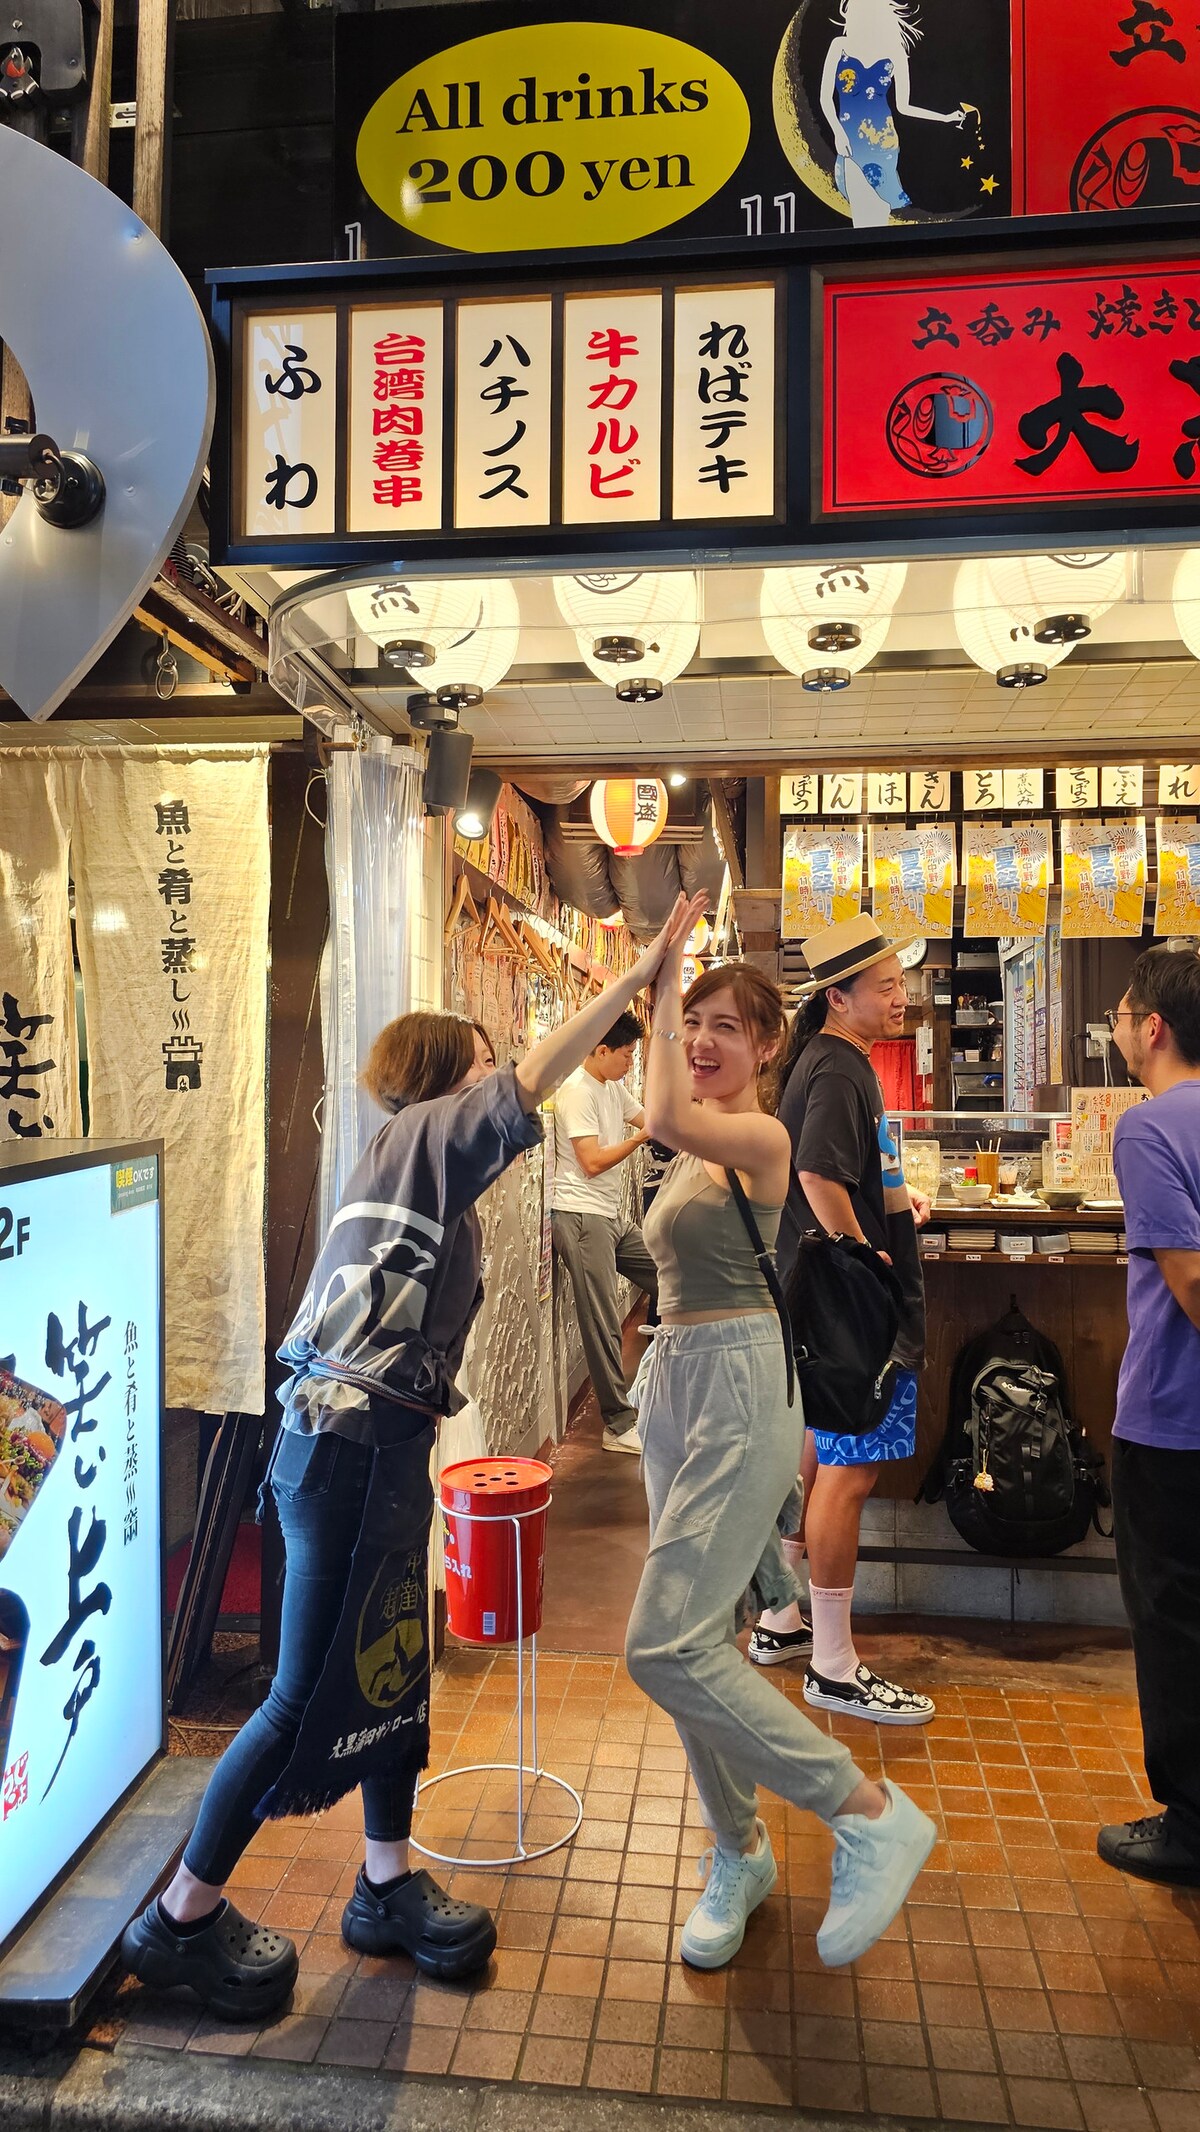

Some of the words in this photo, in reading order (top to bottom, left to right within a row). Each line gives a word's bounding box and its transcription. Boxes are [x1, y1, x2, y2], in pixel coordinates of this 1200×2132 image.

[1107, 0, 1200, 68] 立
[395, 81, 485, 134] All
[502, 67, 710, 126] drinks
[407, 150, 566, 204] 200
[581, 152, 696, 201] yen
[911, 302, 1061, 350] 立呑み
[264, 343, 322, 510] ふわ
[372, 332, 426, 508] 台湾肉巻串
[478, 333, 532, 501] ハチノス
[585, 327, 642, 501] 牛カルビ
[697, 320, 753, 494] ればテキ
[1013, 351, 1200, 480] 大
[878, 772, 903, 806] ほ
[974, 771, 995, 808] とろ
[153, 799, 198, 1003] 魚と肴と蒸し
[0, 1206, 31, 1261] 2F
